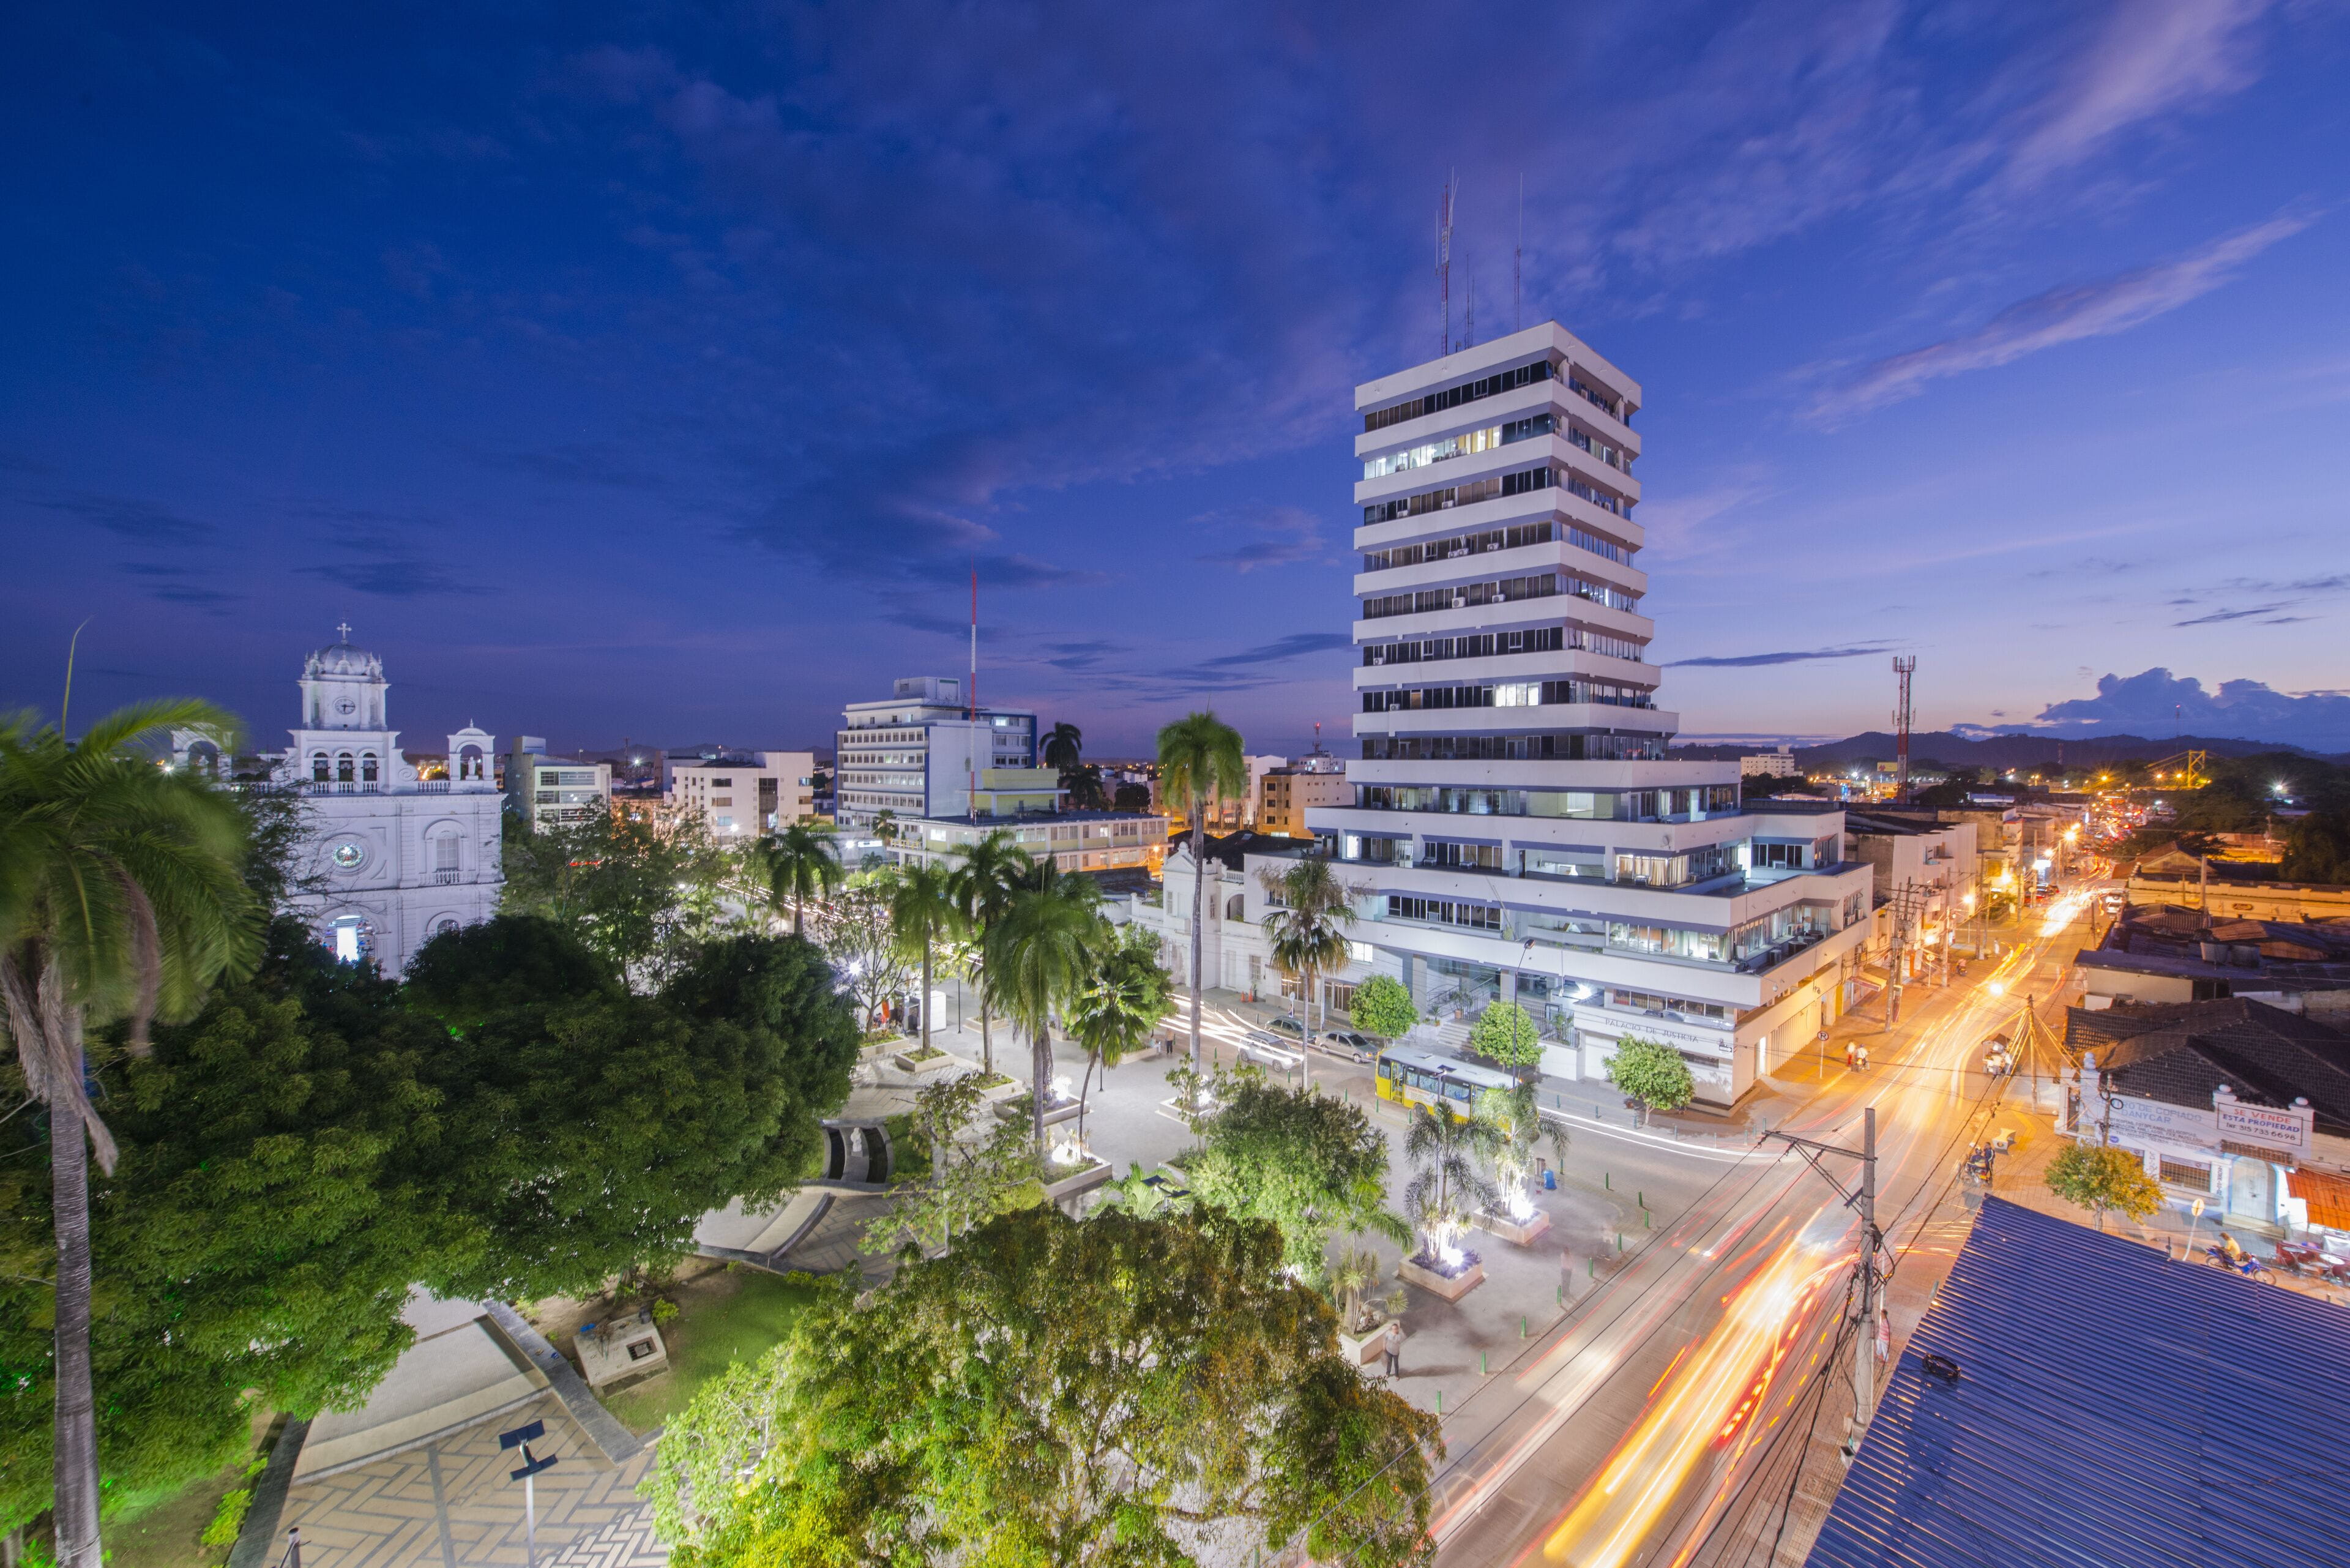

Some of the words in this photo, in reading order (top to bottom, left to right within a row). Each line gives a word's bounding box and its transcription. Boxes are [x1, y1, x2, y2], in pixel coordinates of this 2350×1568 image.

[1605, 1018, 1641, 1031] PALACIO
[1662, 1030, 1699, 1043] JUSTICIA
[2121, 1109, 2171, 1124] DANYCAR
[2138, 1103, 2152, 1113] DE
[2156, 1107, 2202, 1122] COPIADO
[2251, 1111, 2292, 1124] VENDE
[2223, 1114, 2245, 1123] ESTA
[2248, 1119, 2300, 1132] PROPIEDAD
[2271, 1131, 2296, 1141] 6698
